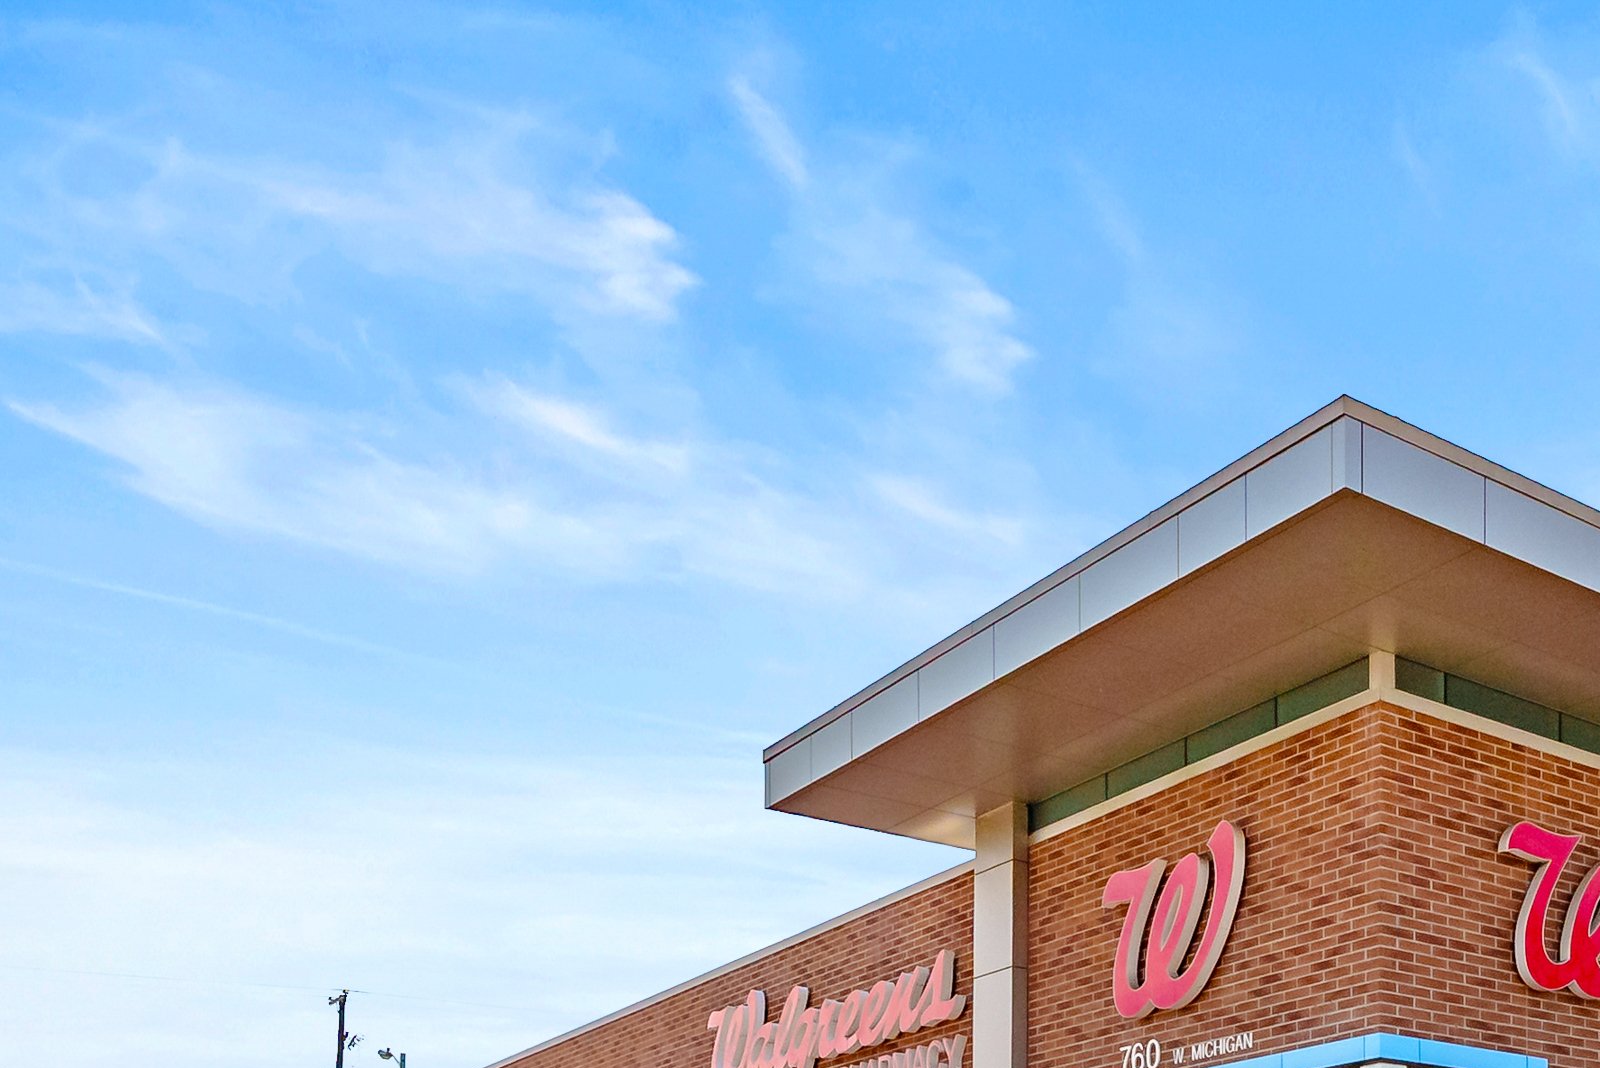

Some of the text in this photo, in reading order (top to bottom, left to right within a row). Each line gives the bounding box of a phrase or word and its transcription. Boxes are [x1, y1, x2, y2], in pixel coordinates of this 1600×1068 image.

[1102, 820, 1245, 1018] W
[1172, 1047, 1187, 1065] W.
[1191, 1032, 1254, 1062] MICHIGAN
